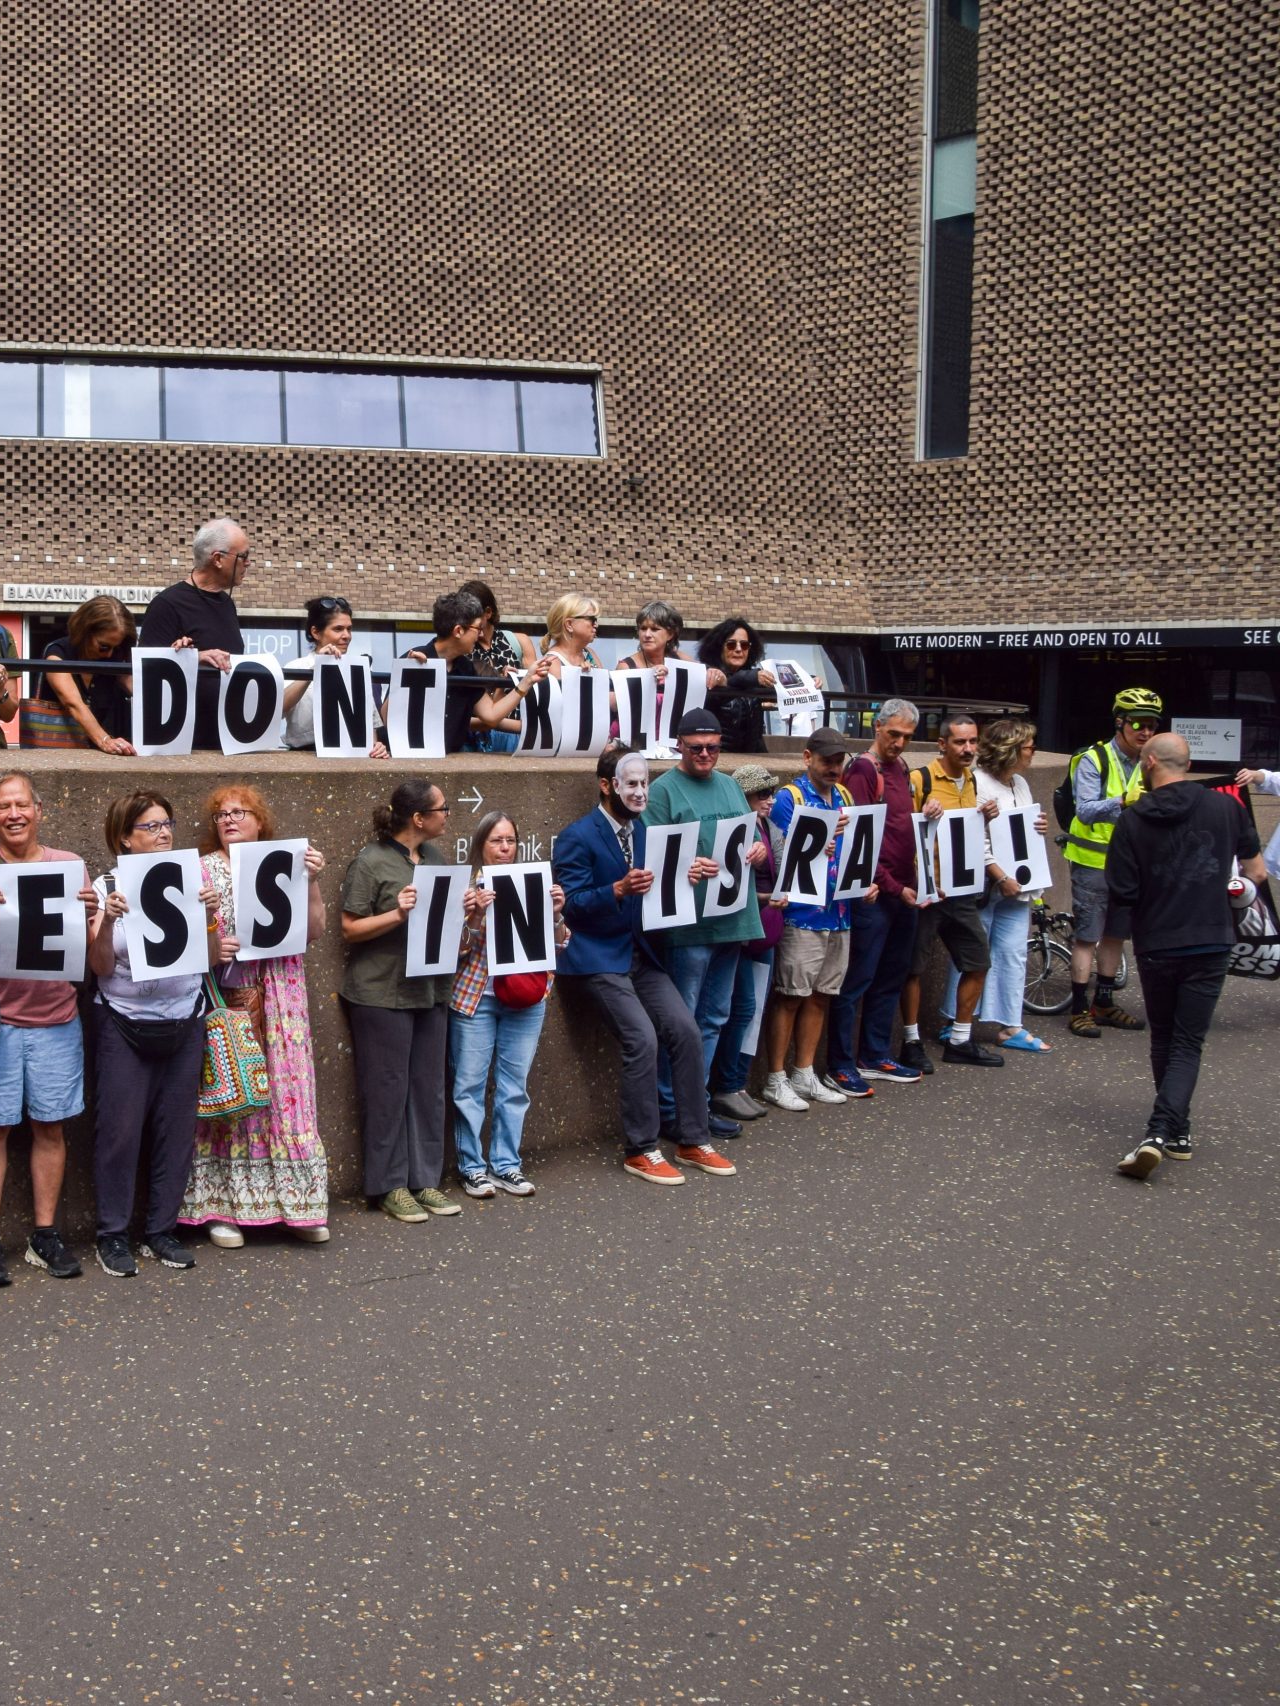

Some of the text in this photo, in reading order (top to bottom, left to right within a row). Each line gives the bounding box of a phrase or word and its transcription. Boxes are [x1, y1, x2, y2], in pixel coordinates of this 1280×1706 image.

[7, 587, 87, 601] BLAVATNIK
[243, 634, 292, 655] HOP
[894, 635, 922, 649] TATE
[926, 634, 982, 648] MODERN
[998, 633, 1028, 647] FREE
[1033, 633, 1063, 646] AND
[1069, 632, 1106, 646] OPEN
[1112, 632, 1131, 645] TO
[1136, 631, 1162, 645] ALL
[1243, 630, 1272, 645] SEE
